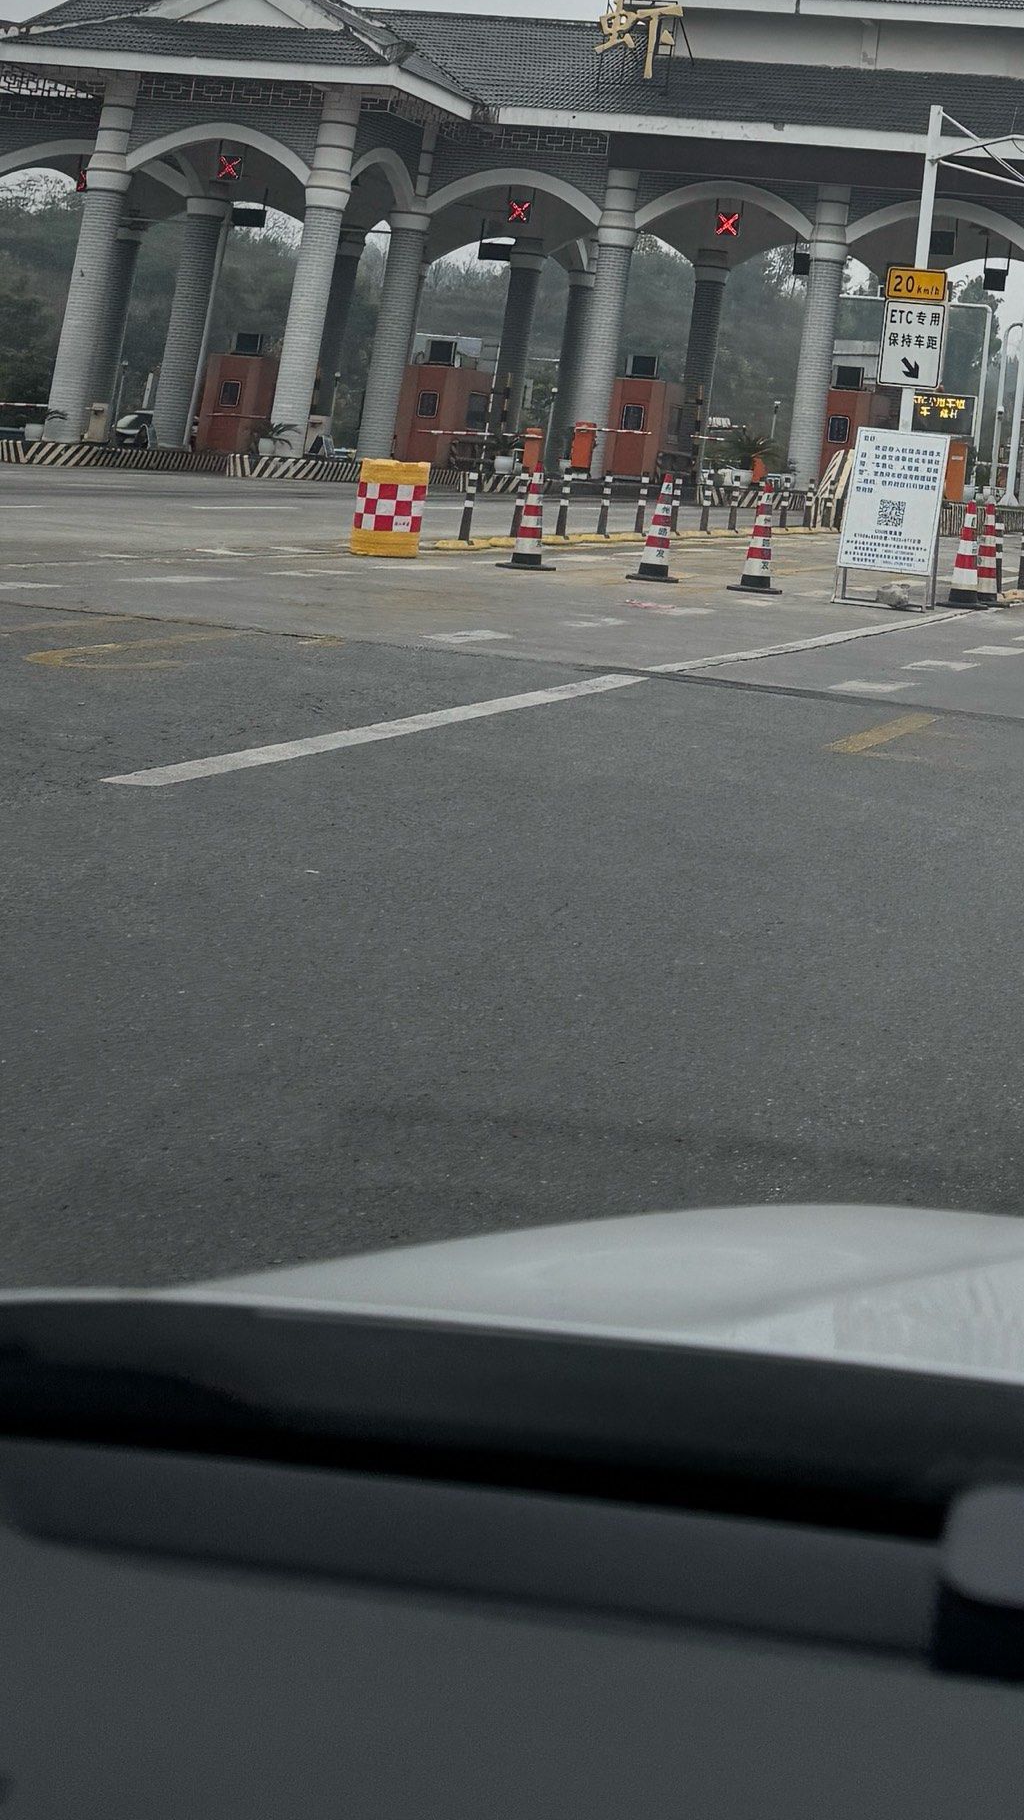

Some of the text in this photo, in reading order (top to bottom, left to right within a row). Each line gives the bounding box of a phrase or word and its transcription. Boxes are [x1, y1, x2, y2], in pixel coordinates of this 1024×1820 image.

[889, 309, 940, 326] ETC专用
[888, 332, 938, 350] 保持车距
